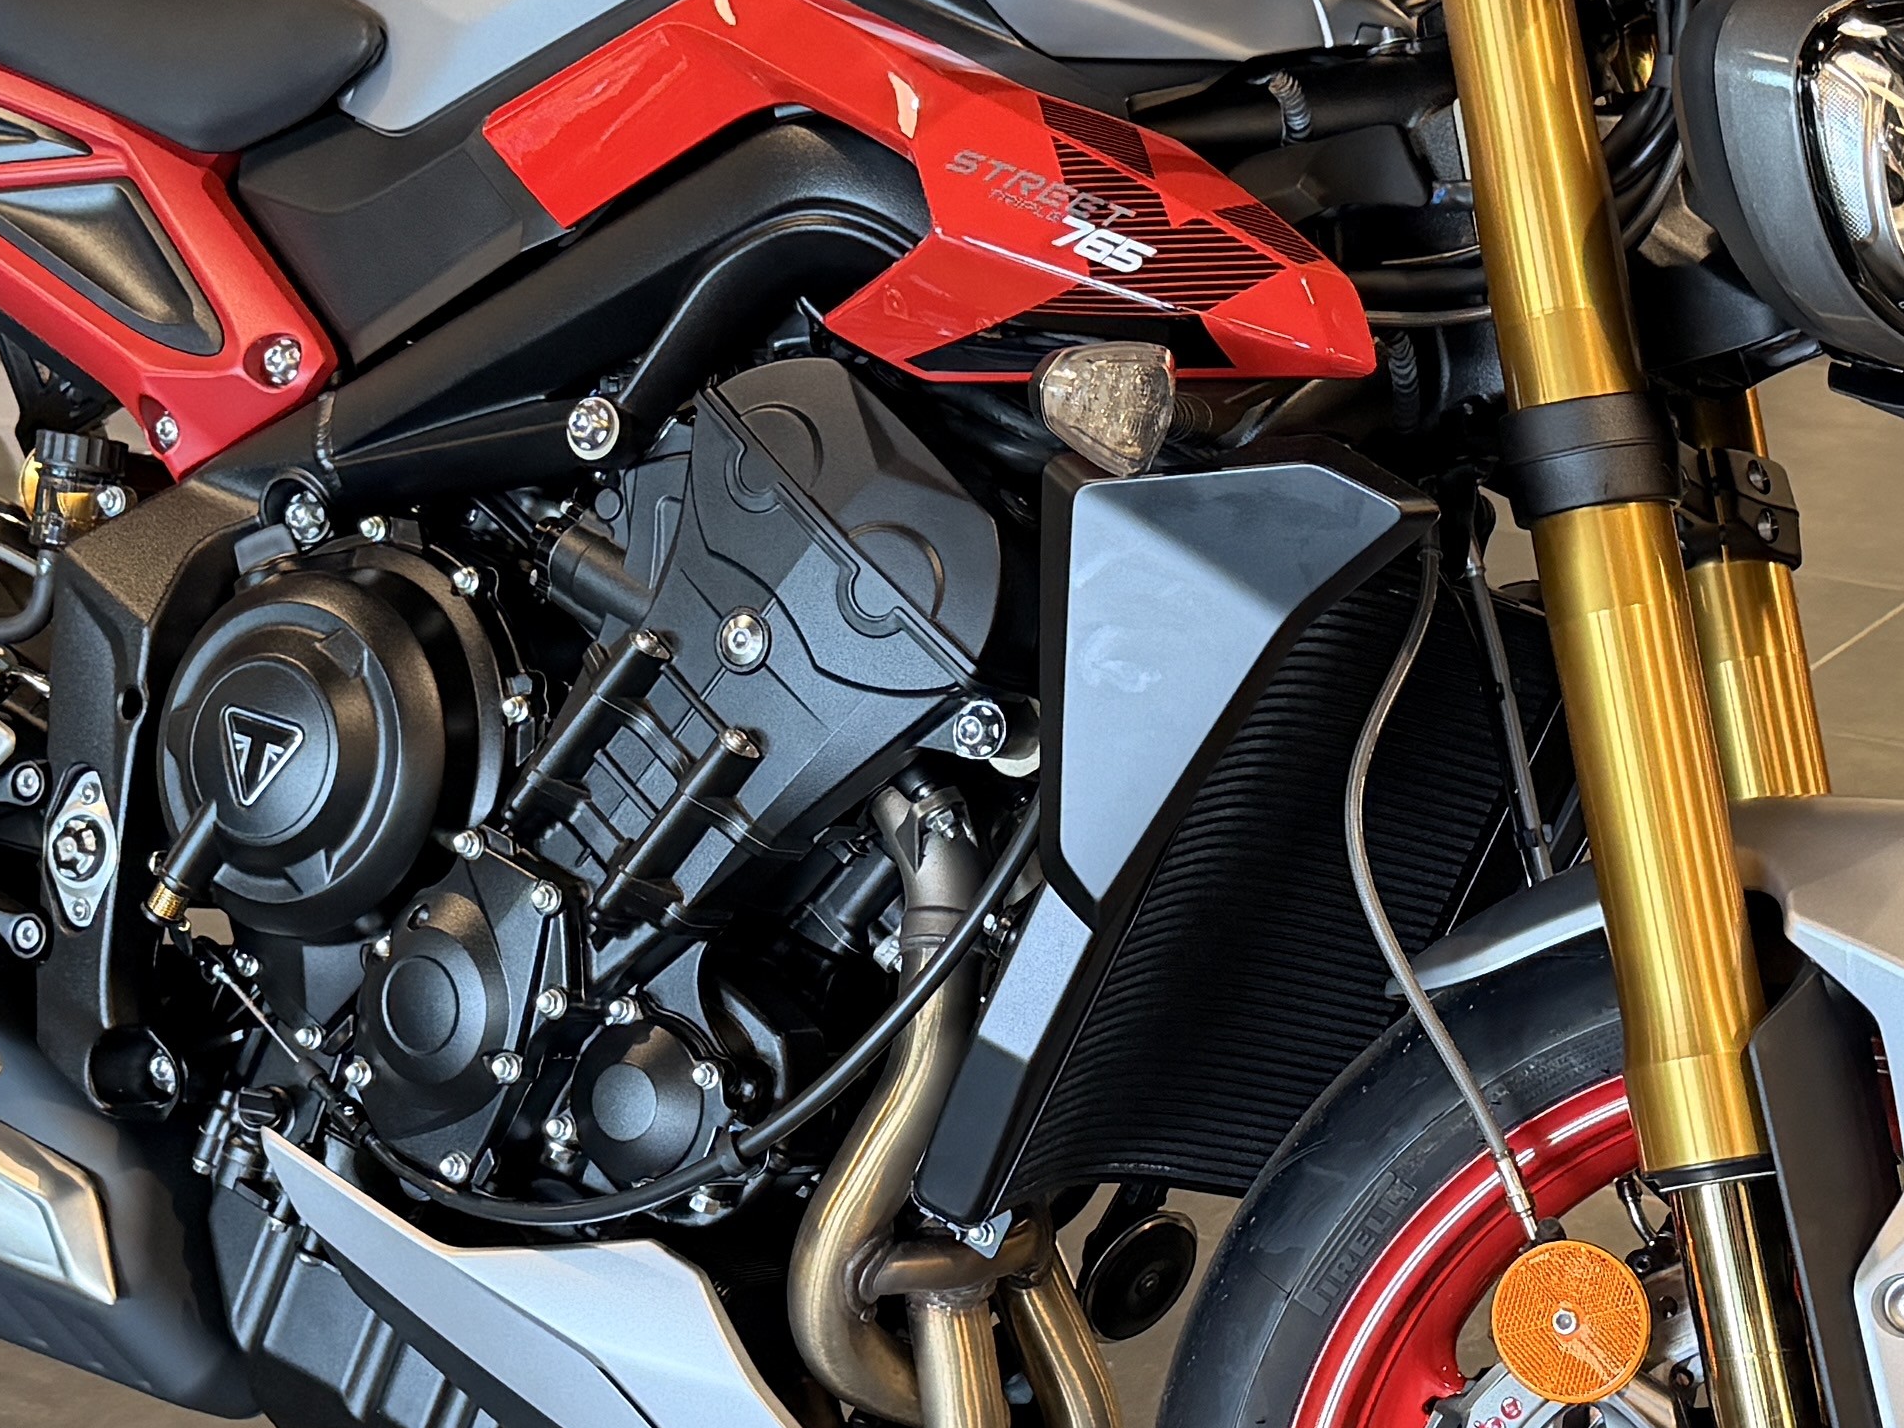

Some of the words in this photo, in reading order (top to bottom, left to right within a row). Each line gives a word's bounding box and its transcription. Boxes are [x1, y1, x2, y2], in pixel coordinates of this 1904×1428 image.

[945, 148, 1137, 228] STREET
[1051, 215, 1158, 273] 765
[1295, 1171, 1417, 1318] PIRELLI
